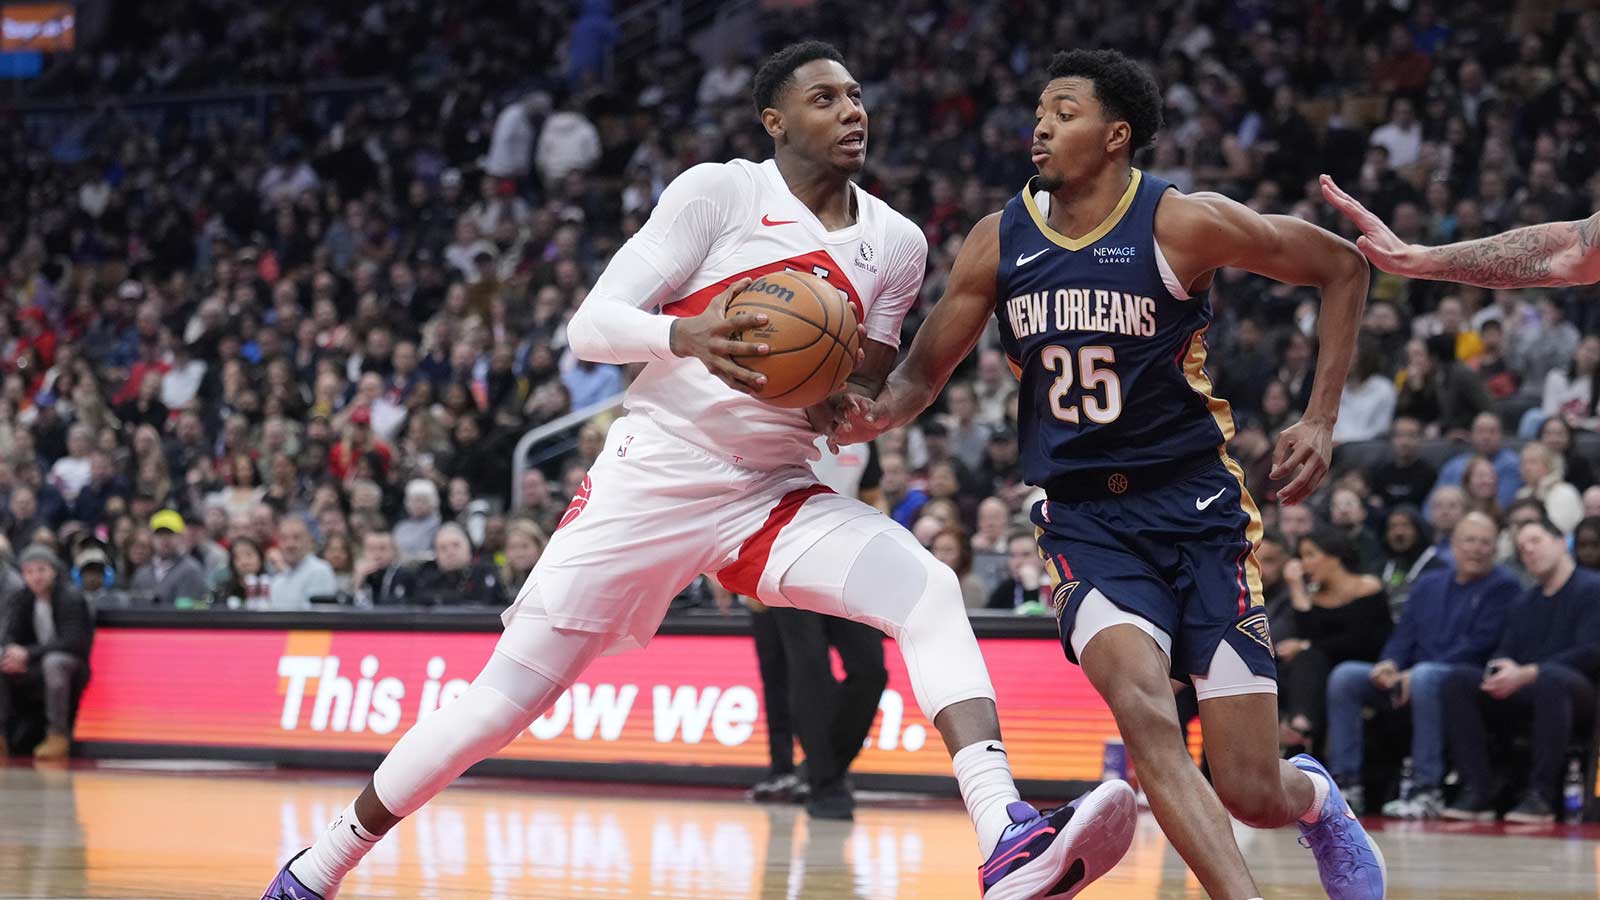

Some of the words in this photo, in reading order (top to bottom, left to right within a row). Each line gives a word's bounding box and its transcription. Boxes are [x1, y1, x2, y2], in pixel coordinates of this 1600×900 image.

[854, 258, 866, 270] Sun
[866, 263, 878, 275] Life
[1093, 246, 1136, 257] NEWAGE
[745, 277, 795, 303] lson
[1006, 290, 1050, 340] NEW
[1054, 288, 1157, 337] ORLEANS
[1041, 344, 1123, 425] 25
[277, 654, 406, 735] This
[524, 680, 639, 742] ow
[651, 684, 759, 747] we
